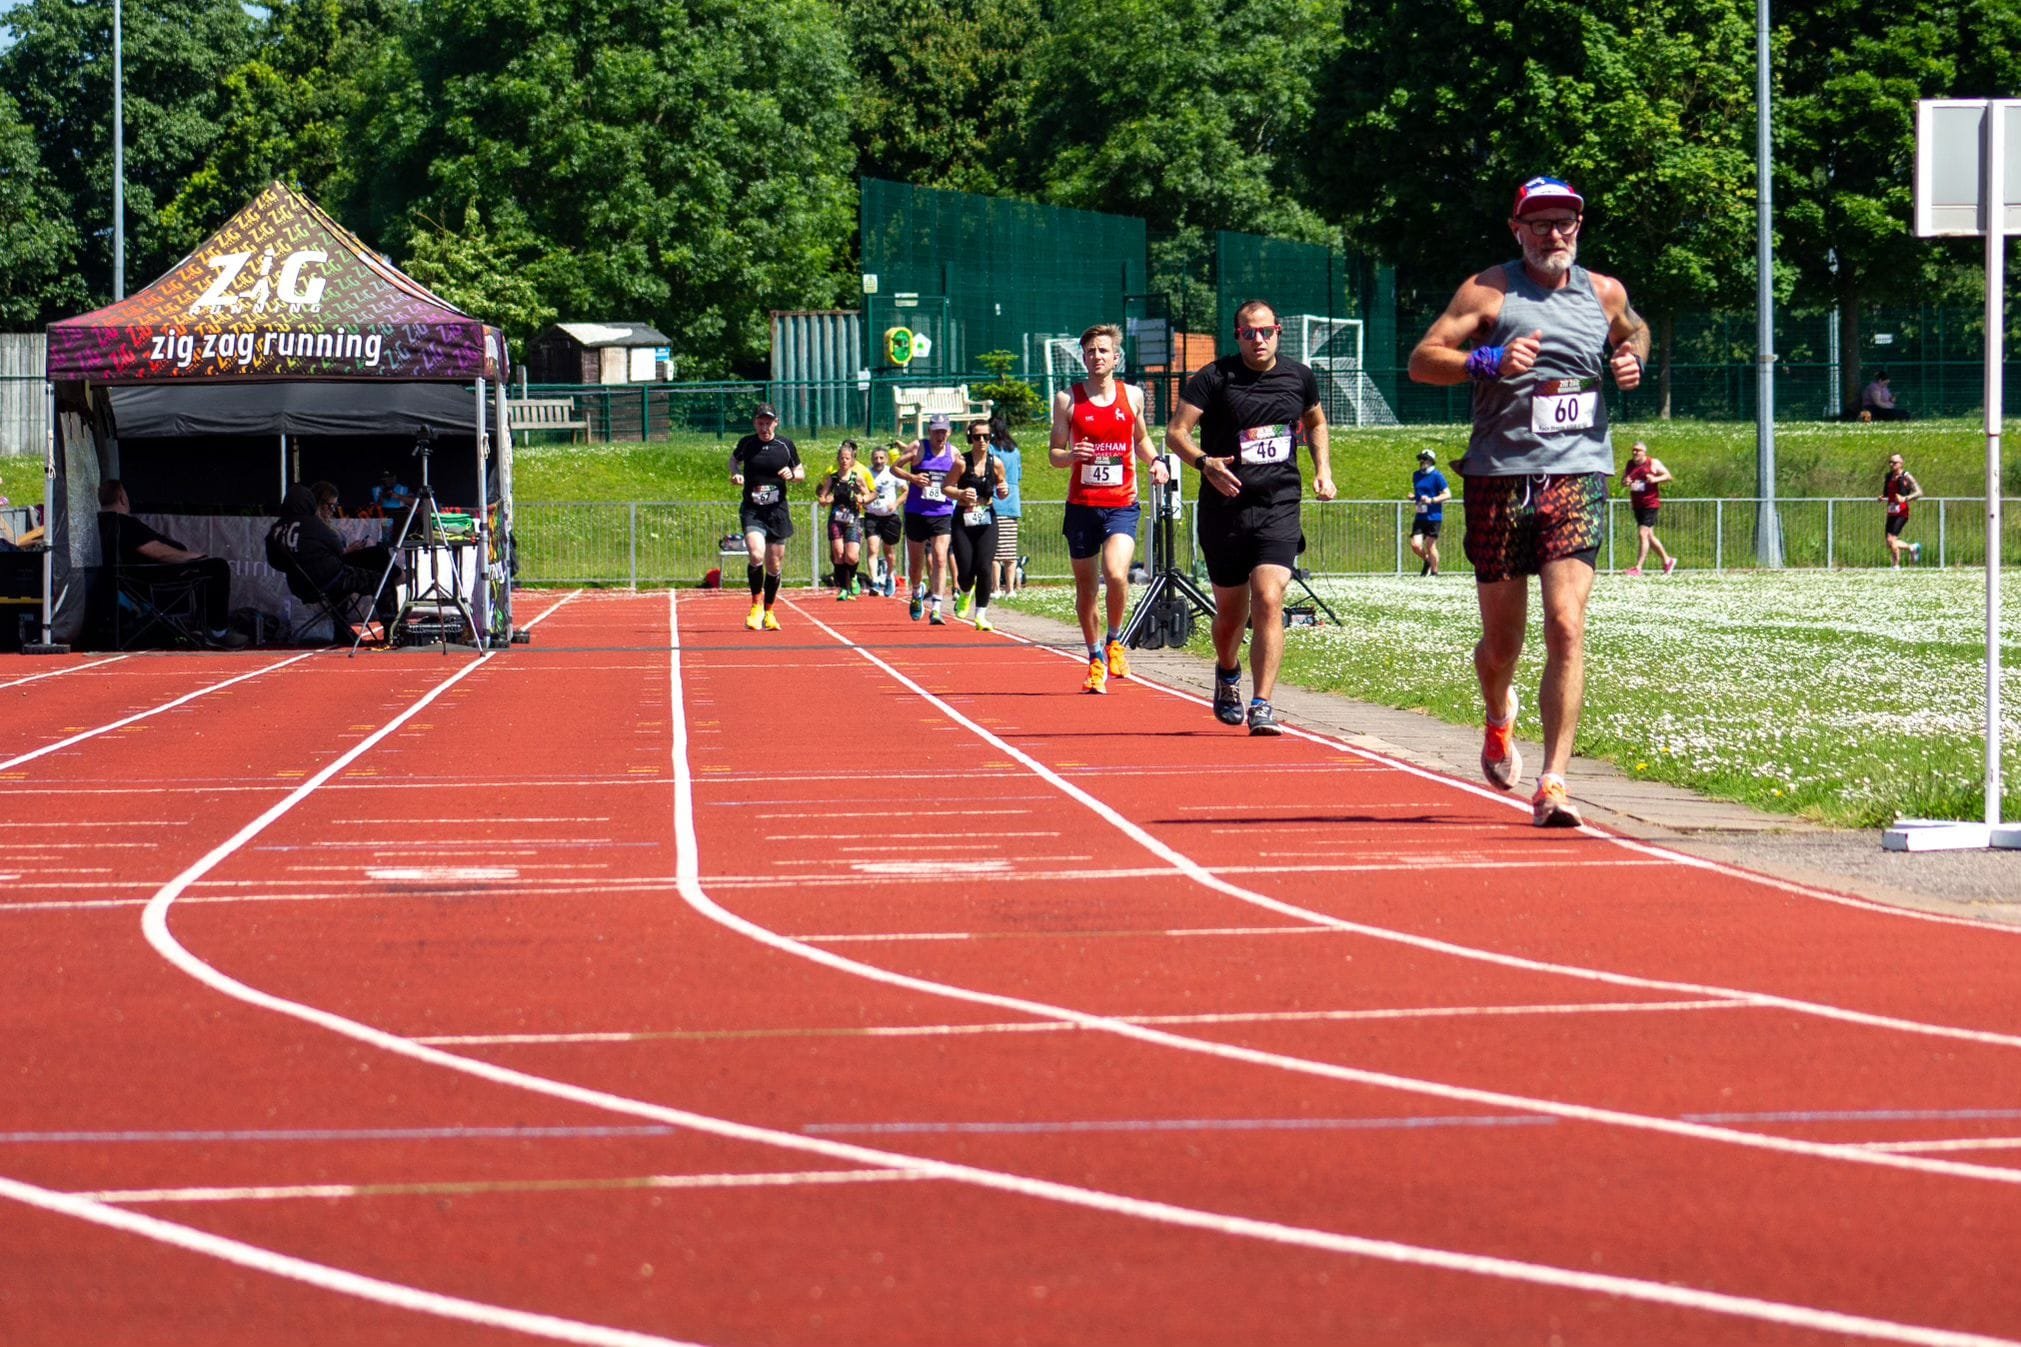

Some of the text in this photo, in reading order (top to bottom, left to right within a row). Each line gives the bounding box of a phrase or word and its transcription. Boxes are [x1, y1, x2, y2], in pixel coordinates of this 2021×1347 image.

[151, 327, 383, 367] zig zag running
[1555, 398, 1578, 422] 60
[1257, 440, 1276, 458] 46
[1093, 467, 1109, 481] 45
[760, 492, 770, 502] 67
